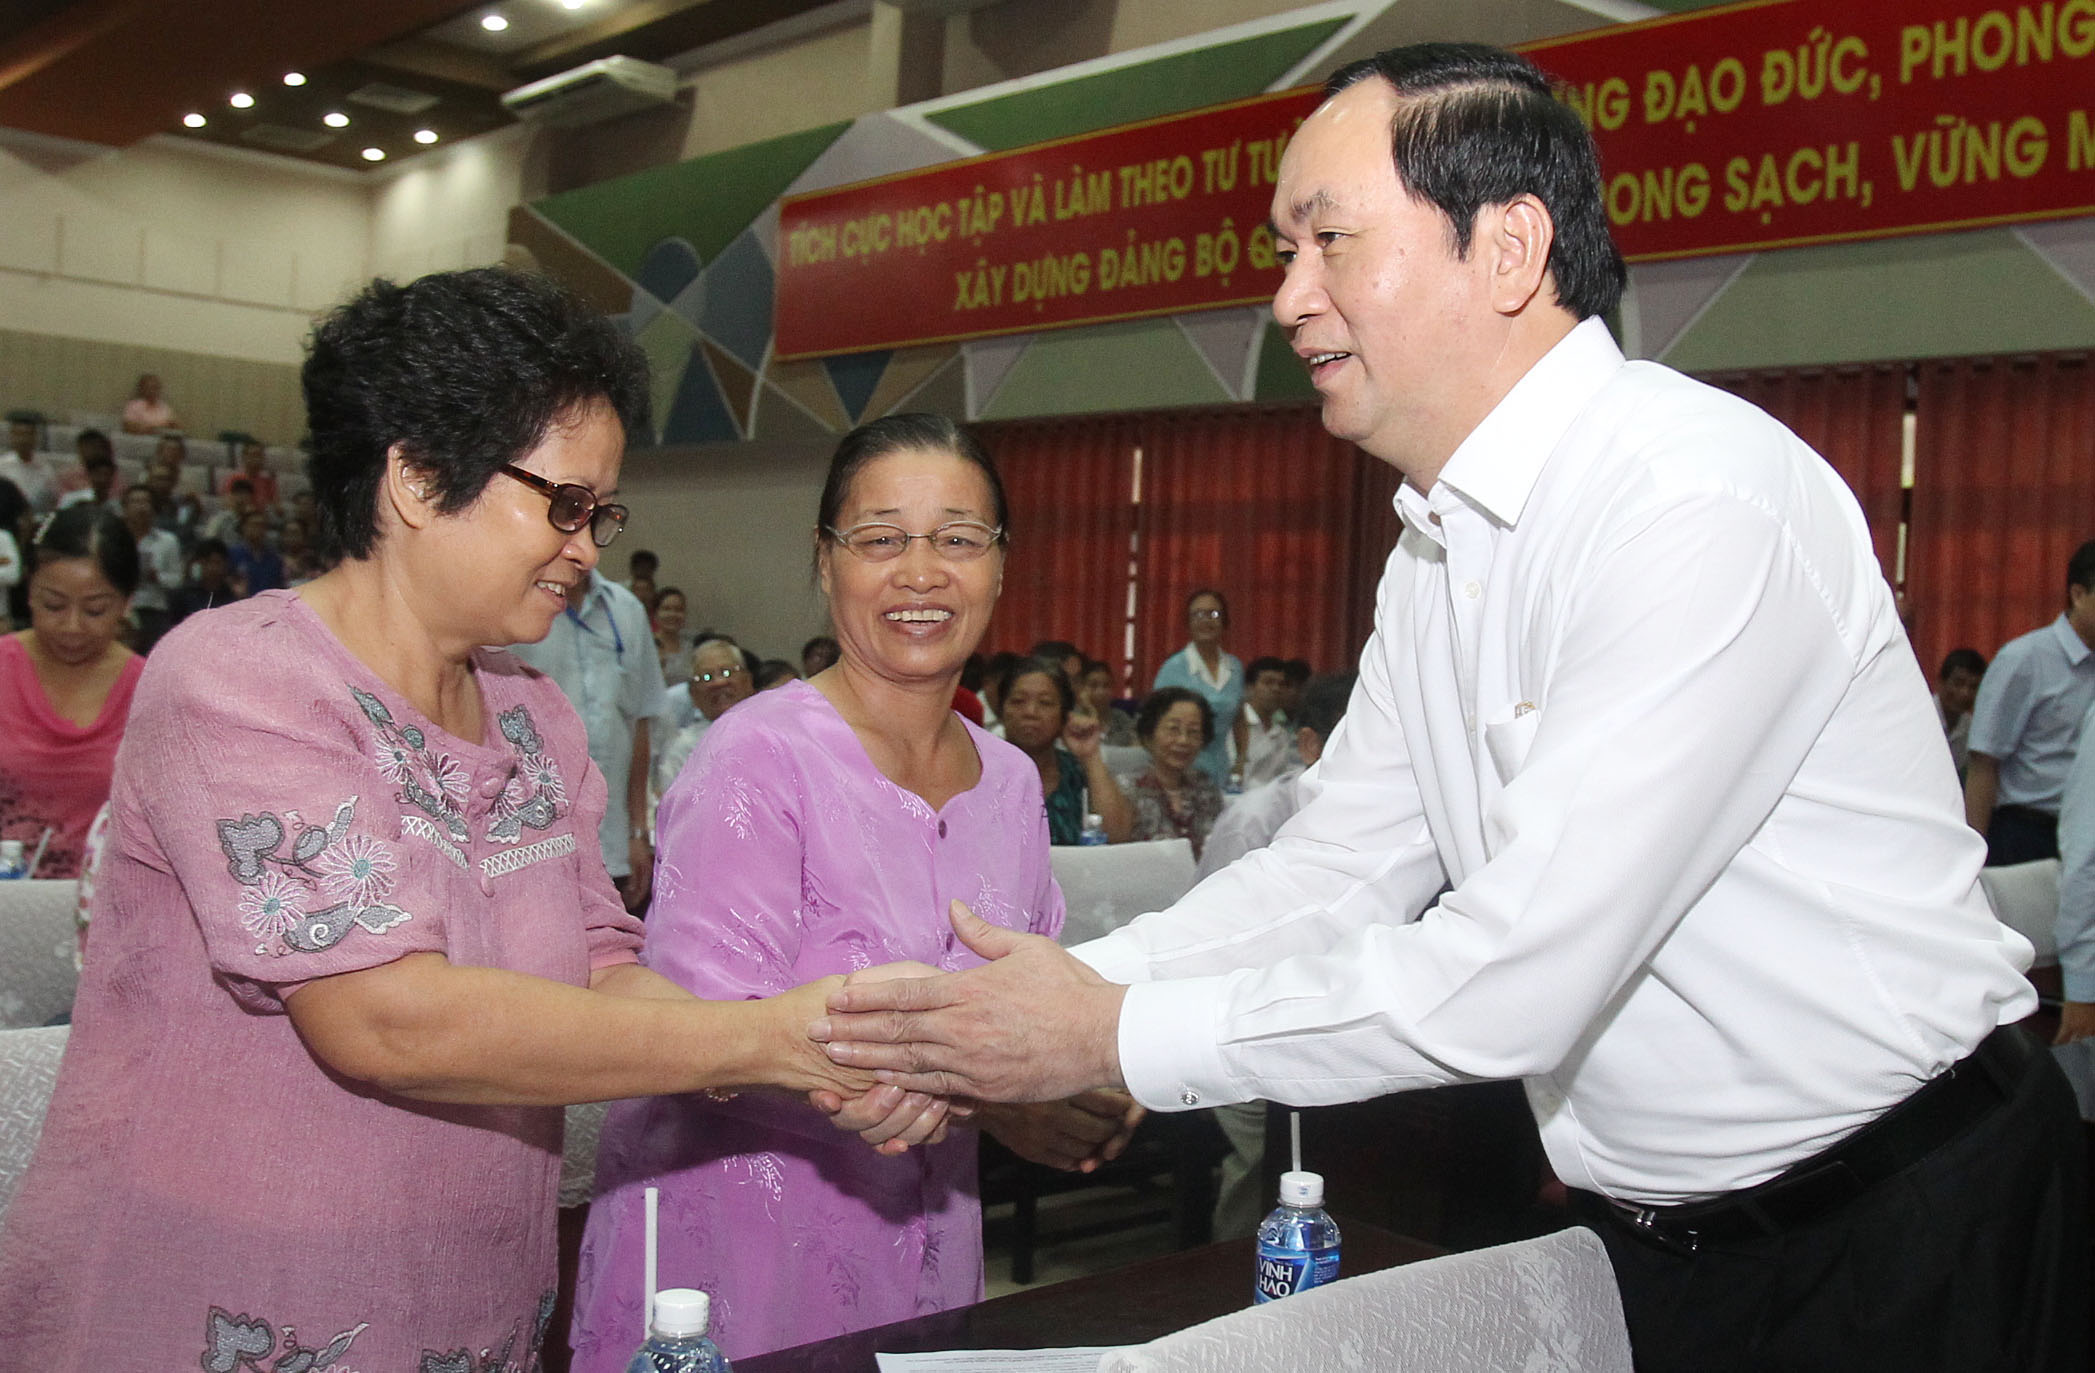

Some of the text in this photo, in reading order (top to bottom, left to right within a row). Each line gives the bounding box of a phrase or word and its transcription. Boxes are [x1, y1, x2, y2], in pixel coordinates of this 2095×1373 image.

[1643, 57, 1747, 134] ĐẠO
[1761, 26, 1882, 105] ĐỨC,
[1899, 0, 2095, 84] PHONG
[842, 211, 892, 265] CỰC
[896, 202, 951, 255] HỌC
[957, 184, 1004, 246] TẬP
[1010, 172, 1048, 226] VÀ
[1055, 163, 1111, 220] LÀM
[1119, 154, 1194, 208] THEO
[1202, 138, 1241, 194] TƯ
[1600, 162, 1710, 226] ONG
[1723, 141, 1874, 224] SẠCH,
[1891, 114, 2049, 191] VỮNG
[954, 257, 1007, 310] XÂY
[1013, 250, 1091, 313] DỰNG
[1099, 228, 1186, 291] ĐẢNG
[1195, 217, 1240, 287] BỘ
